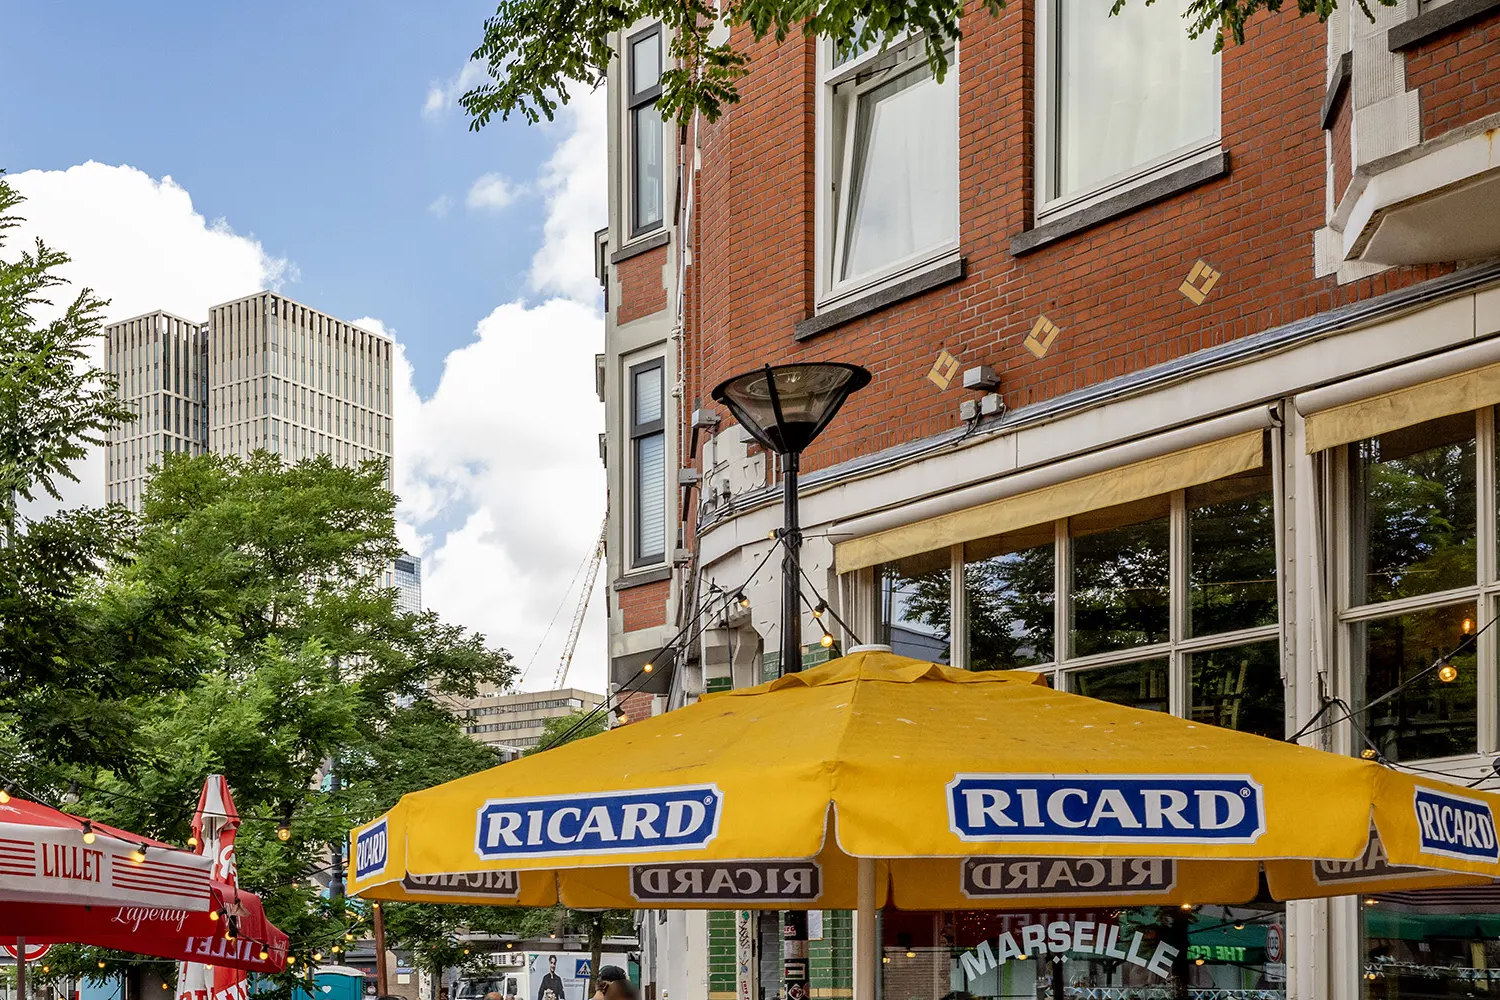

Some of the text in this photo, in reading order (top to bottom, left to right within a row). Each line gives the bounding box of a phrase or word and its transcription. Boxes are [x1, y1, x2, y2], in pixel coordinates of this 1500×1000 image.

[486, 800, 706, 848] RICARD
[961, 788, 1245, 829] RICARD
[1417, 801, 1495, 850] RICARD
[41, 843, 104, 883] LILLET
[356, 831, 385, 871] RICARD
[959, 920, 1180, 982] MARSEILLE
